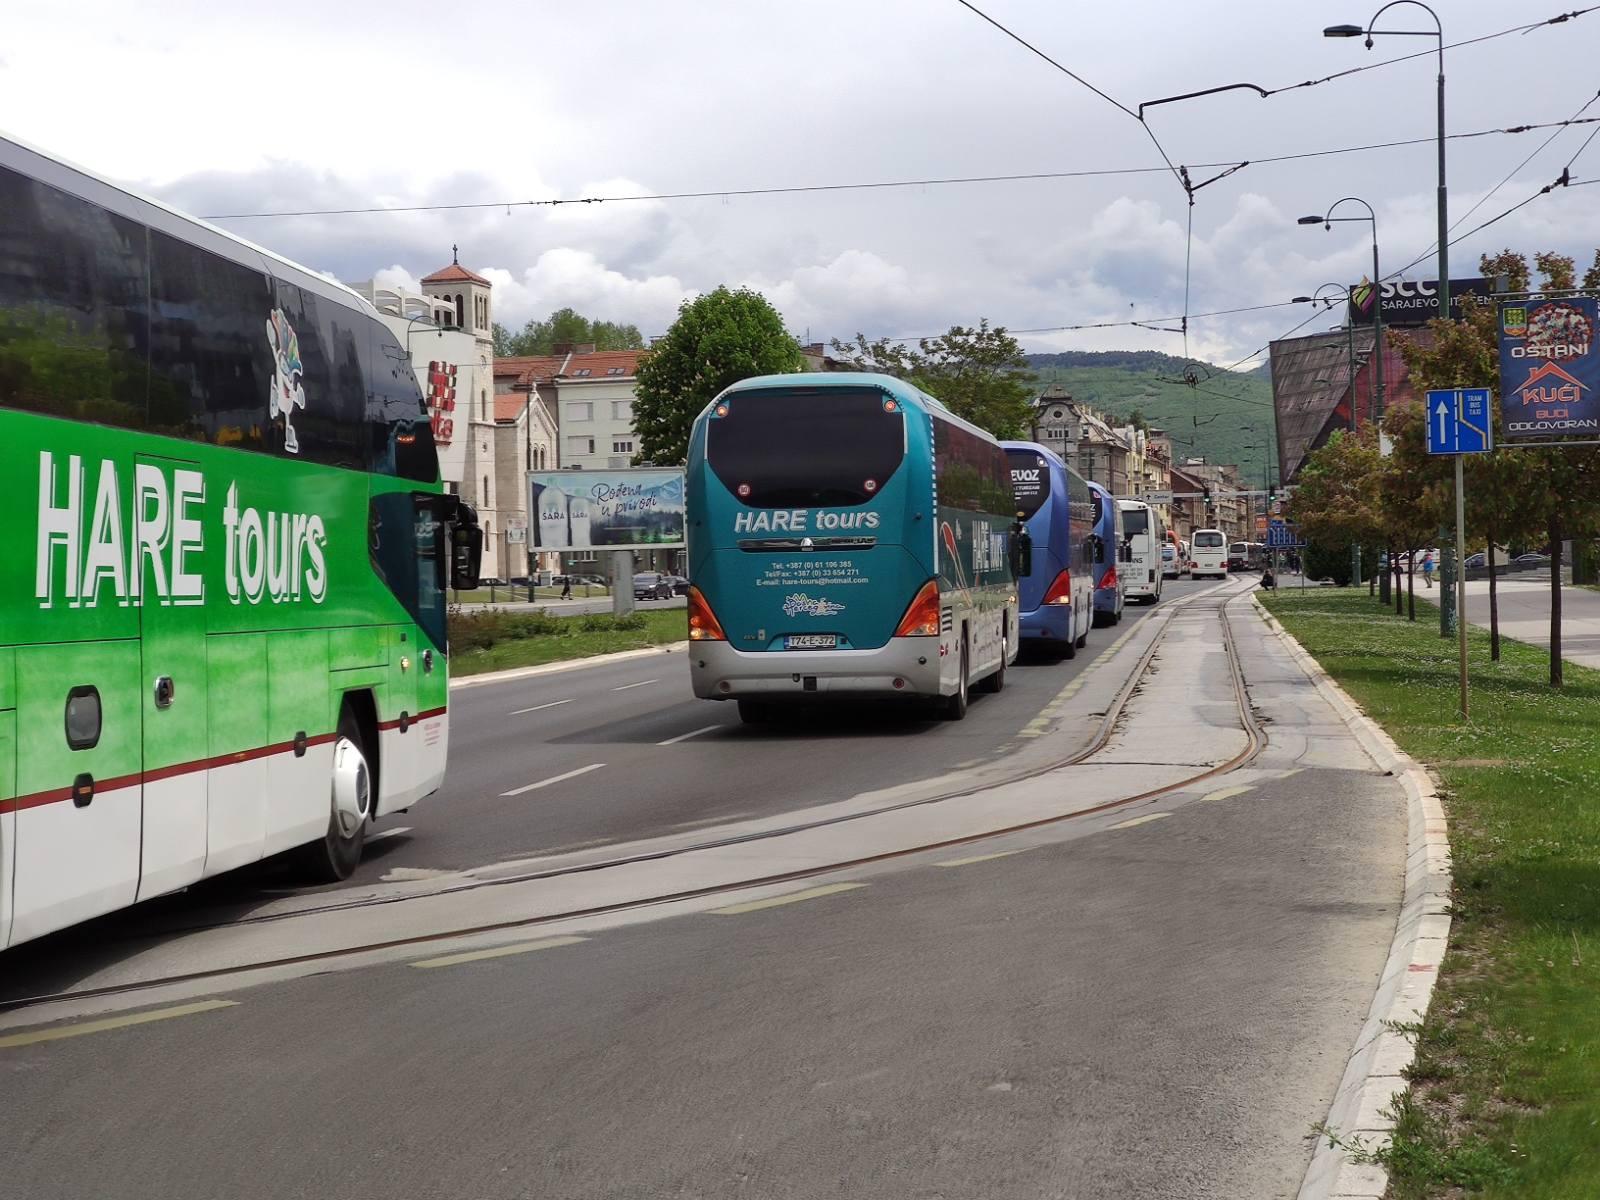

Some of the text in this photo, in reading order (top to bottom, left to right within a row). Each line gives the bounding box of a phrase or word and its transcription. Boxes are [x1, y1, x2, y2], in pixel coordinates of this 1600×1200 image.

[1381, 298, 1440, 310] SARAJEVO
[1511, 343, 1589, 359] OSTANI
[1522, 383, 1581, 406] KUĆI
[1508, 419, 1598, 431] ODGOVORAN
[542, 512, 565, 521] SARA
[601, 505, 611, 517] u
[734, 509, 881, 533] HARE tours
[35, 450, 328, 609] HARE tours
[804, 561, 814, 569] (0)
[847, 568, 859, 576] 271
[791, 635, 834, 645] T74-E-372
